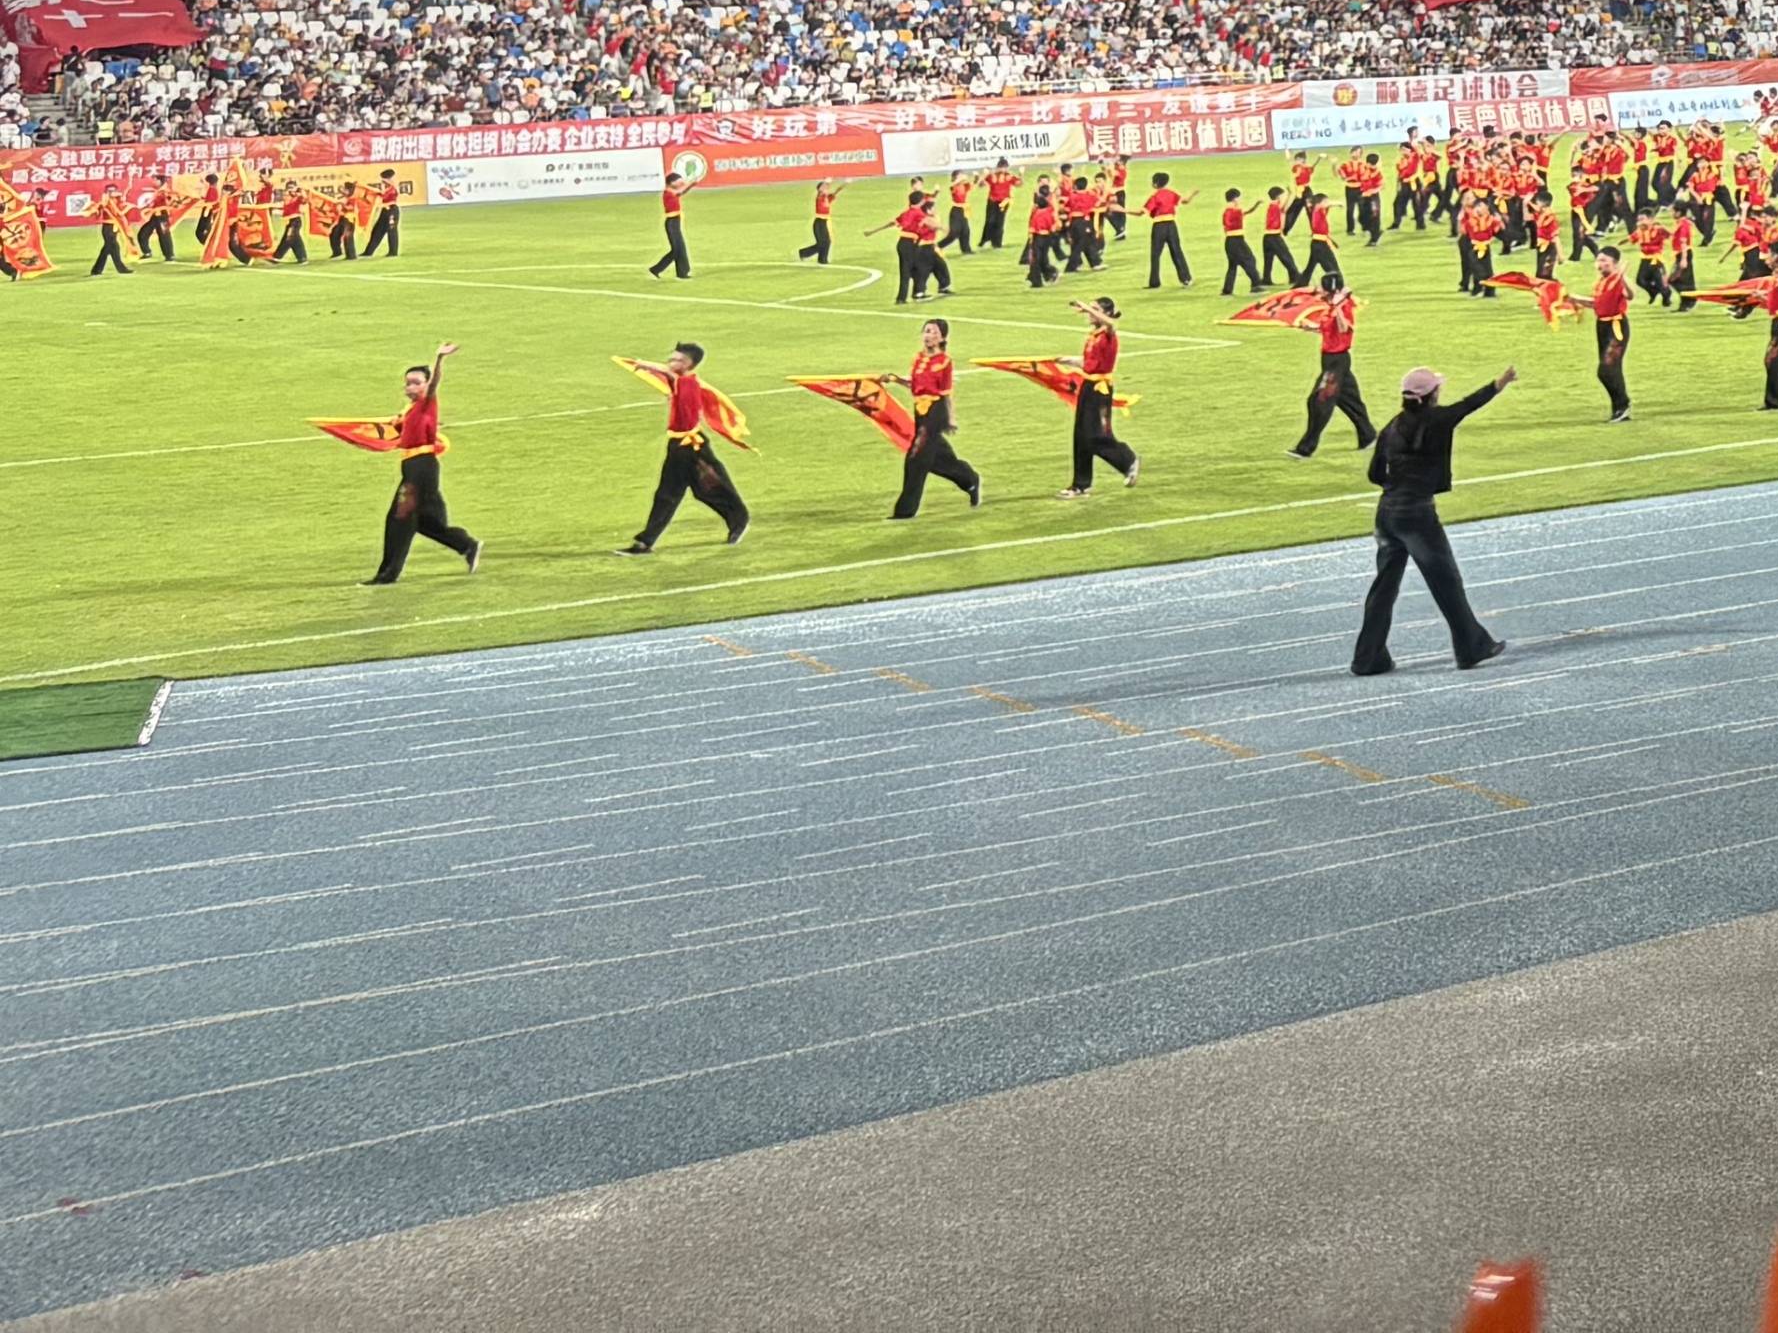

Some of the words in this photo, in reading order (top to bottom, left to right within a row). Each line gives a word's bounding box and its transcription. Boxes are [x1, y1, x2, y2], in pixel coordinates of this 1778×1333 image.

[1376, 73, 1538, 104] 顺德足球协会
[371, 134, 433, 162] 政府出题
[501, 126, 562, 155] 协会办赛
[564, 123, 624, 151] 企业支持
